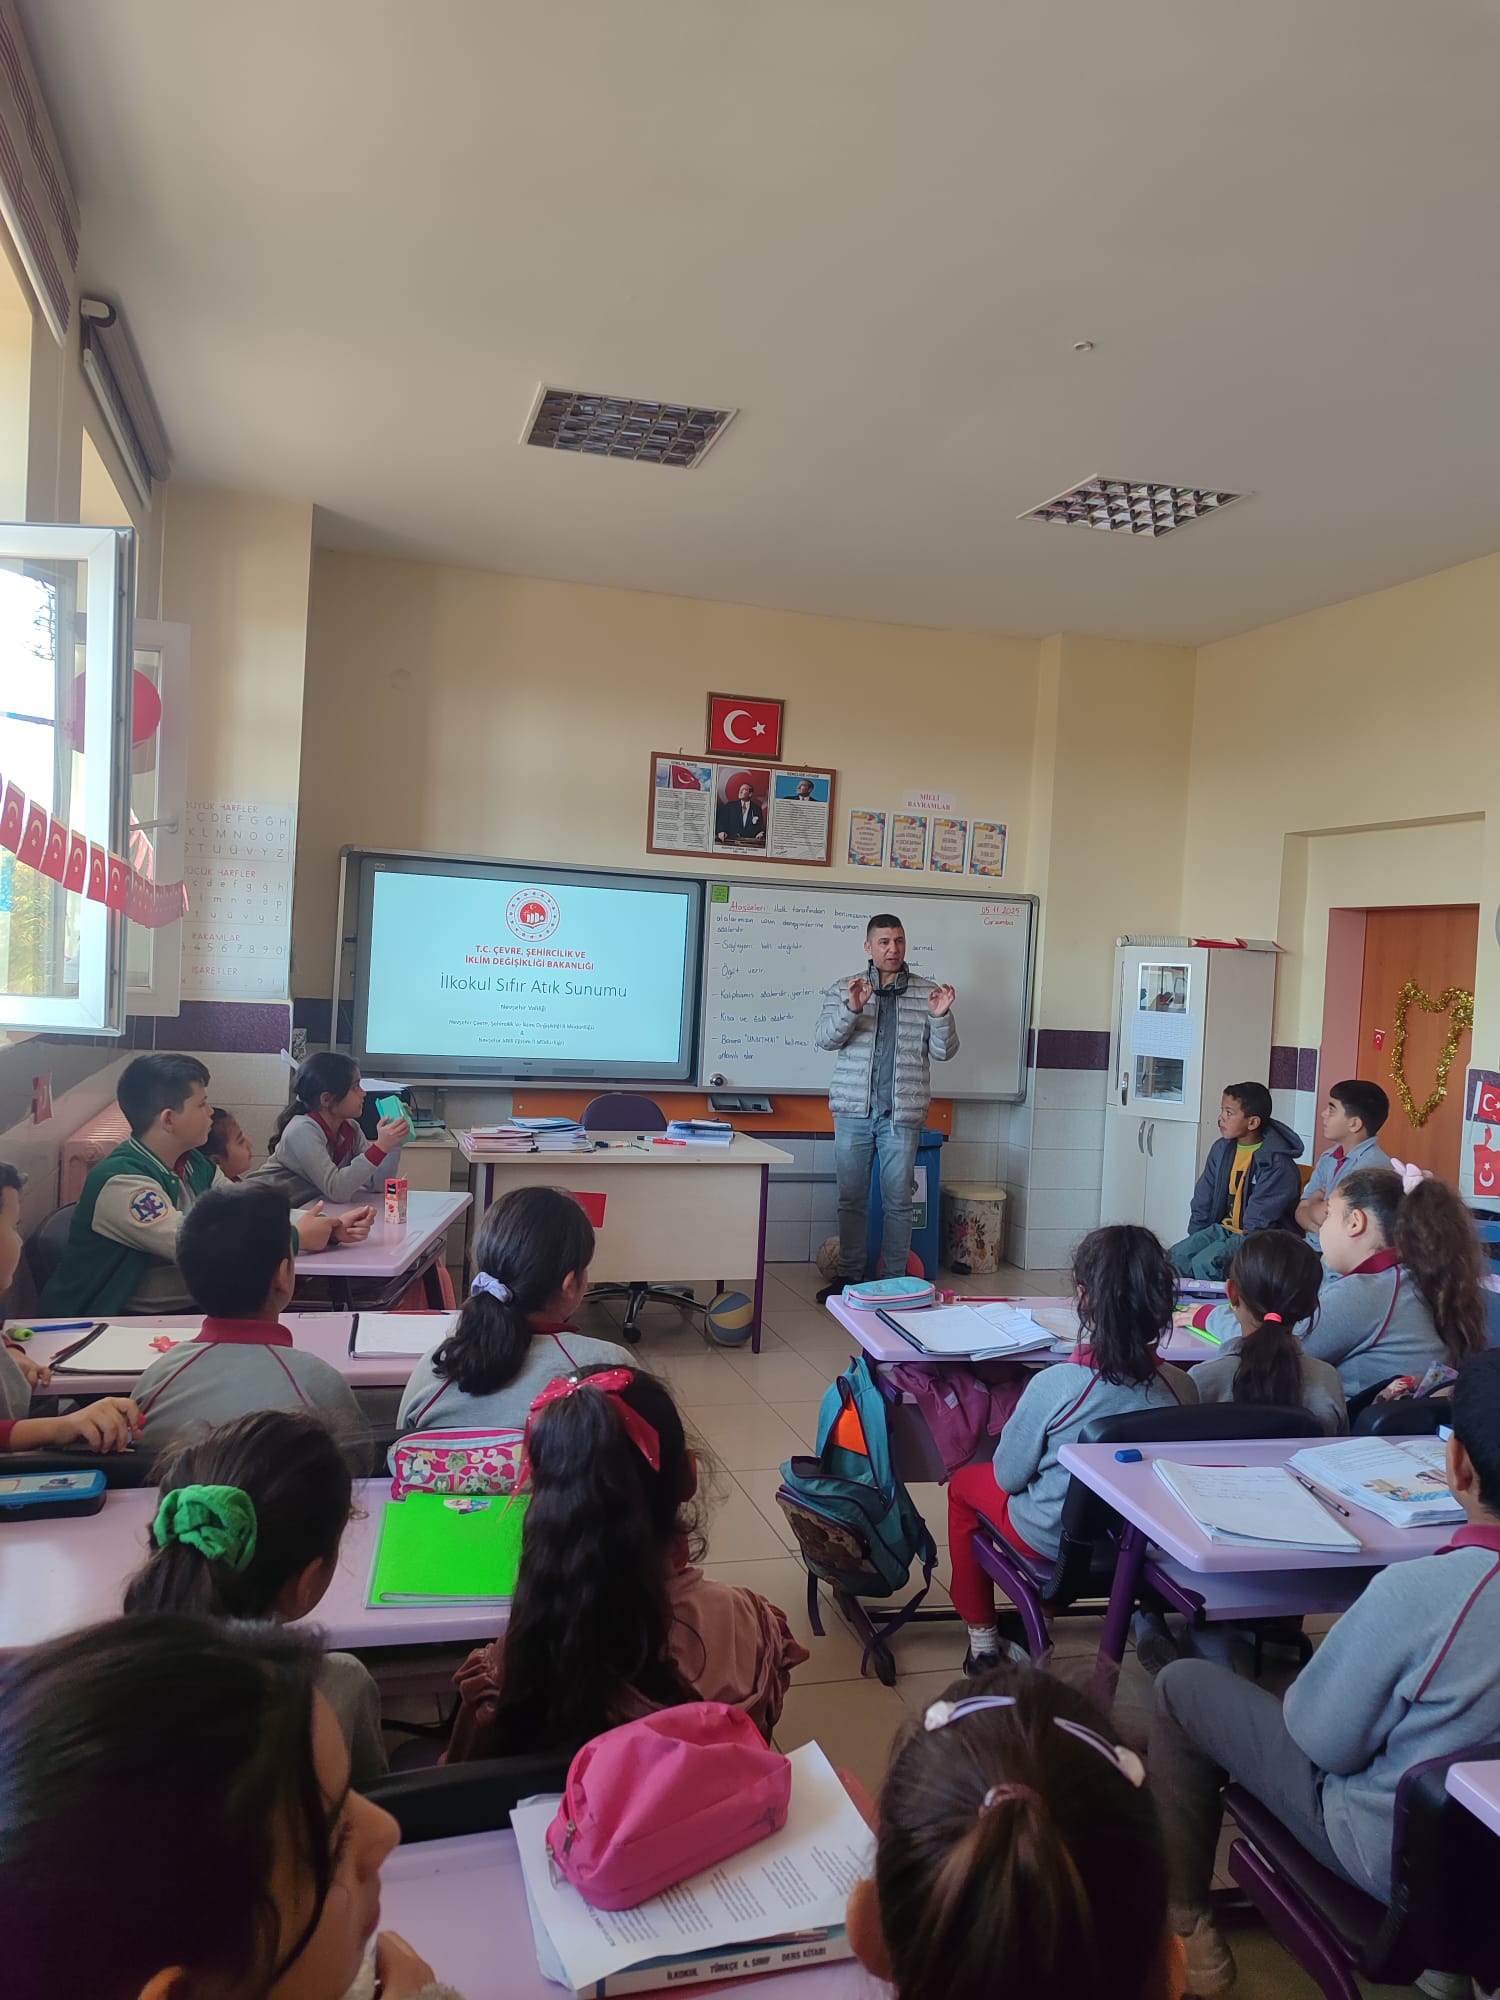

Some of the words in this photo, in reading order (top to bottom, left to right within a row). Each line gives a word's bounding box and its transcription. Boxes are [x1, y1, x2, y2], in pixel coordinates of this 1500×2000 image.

[493, 946, 524, 956] ÇEVRE,
[526, 948, 573, 958] ŞEHİRCİLİK
[465, 955, 490, 964] İKLİM
[493, 957, 544, 968] DEĞİŞİKLİĞİ
[547, 960, 594, 970] BAKANLIĞI
[440, 972, 491, 991] İlkokul
[496, 977, 526, 993] Sıfır
[531, 980, 560, 995] Atık
[565, 981, 627, 998] Sunumu
[667, 1968, 698, 1981] İLKOKUL
[710, 1961, 739, 1974] TÜRKÇE
[752, 1956, 771, 1968] SINIF
[782, 1952, 800, 1962] DERS
[802, 1947, 827, 1959] KİTABI
